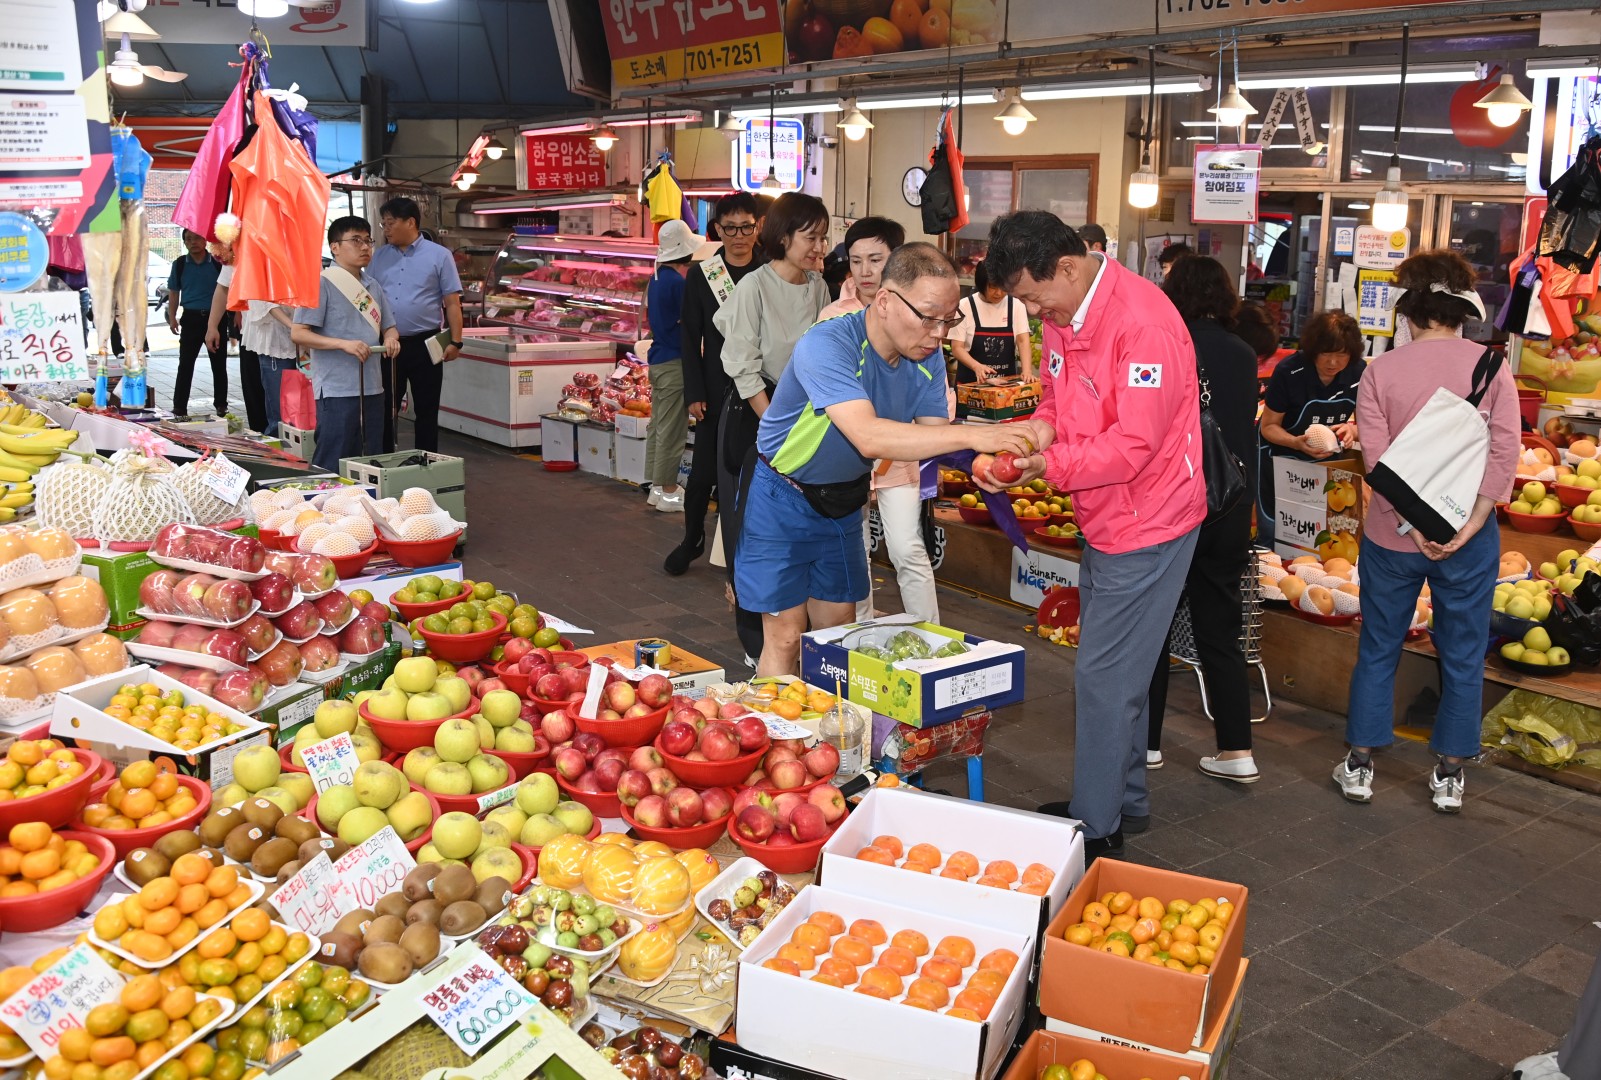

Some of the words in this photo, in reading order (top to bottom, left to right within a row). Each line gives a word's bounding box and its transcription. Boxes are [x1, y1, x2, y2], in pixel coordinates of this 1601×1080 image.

[686, 41, 762, 72] 701-7251
[532, 141, 601, 167] 한우암소촌
[1204, 180, 1246, 193] 참여점포
[21, 329, 73, 363] 직송
[1029, 565, 1067, 585] Sun&Fun
[820, 659, 848, 683] 스타영천
[850, 669, 878, 693] 스타포도
[294, 882, 342, 936] 만원
